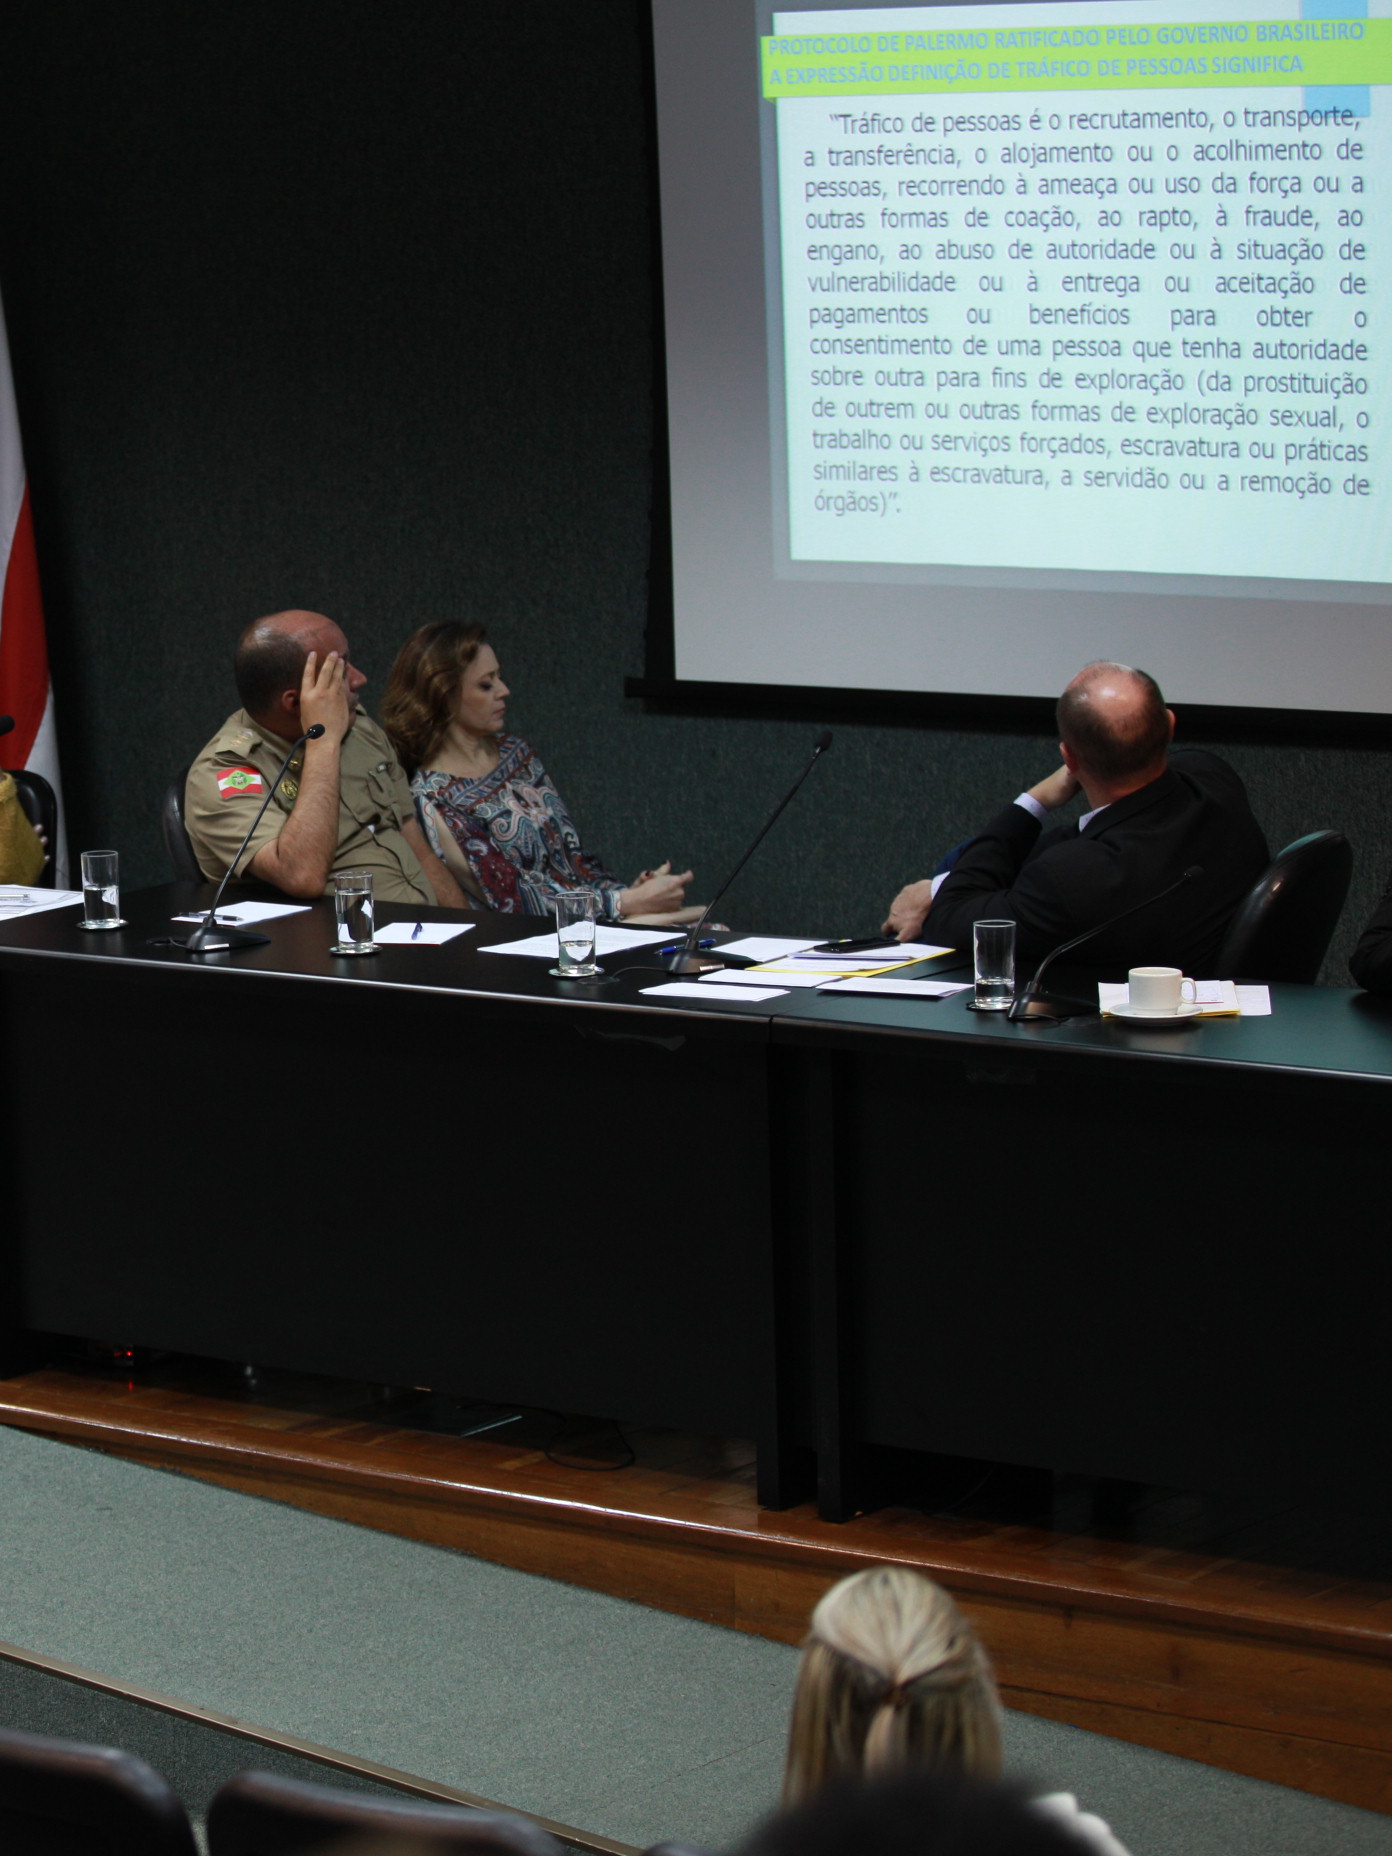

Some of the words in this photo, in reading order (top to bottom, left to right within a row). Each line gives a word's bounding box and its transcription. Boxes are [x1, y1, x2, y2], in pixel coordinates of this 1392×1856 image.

[769, 35, 872, 55] PROTOCOLO
[877, 34, 900, 52] DE
[905, 32, 989, 51] PALERMO
[995, 29, 1100, 49] RATIFICADO
[1107, 28, 1151, 46] PELO
[1157, 25, 1249, 44] GOVERNO
[1257, 22, 1365, 42] BRASILEIRO
[770, 69, 782, 85] A
[786, 62, 884, 84] EXPRESSÃO
[888, 59, 981, 84] DEFINIÇÃO
[988, 62, 1011, 79] DE
[1017, 56, 1090, 78] TRÁFICO
[1098, 59, 1121, 77] DE
[1127, 57, 1208, 75] PESSOAS
[1212, 55, 1304, 74] SIGNIFICA
[911, 112, 937, 133] de
[943, 114, 1023, 138] pessoas
[1029, 107, 1043, 131] é
[1048, 113, 1062, 131] o
[1069, 107, 1215, 132] recrutamento,
[1223, 110, 1238, 128] o
[1243, 105, 1360, 133] transporte,
[804, 150, 816, 167] a
[827, 142, 961, 167] transferência,
[975, 147, 988, 165] o
[1001, 142, 1115, 169] alojamento
[1127, 145, 1154, 163] ou
[1166, 144, 1180, 162] o
[1193, 138, 1323, 162] acolhimento
[1336, 137, 1365, 161] de
[805, 179, 887, 203] pessoas,
[898, 174, 1006, 197] recorrendo
[1015, 172, 1029, 195] à
[1038, 177, 1119, 200] ameaça
[1128, 177, 1155, 195] ou
[1165, 176, 1203, 194] uso
[1211, 171, 1239, 194] da
[1249, 170, 1303, 199] força
[1313, 175, 1341, 194] ou
[1351, 175, 1365, 194] a
[805, 210, 866, 229] outras
[880, 207, 949, 229] formas
[964, 206, 991, 228] de
[1004, 205, 1081, 233] coação,
[1097, 209, 1123, 227] ao
[1139, 206, 1199, 232] rapto,
[1215, 203, 1229, 227] à
[1245, 204, 1321, 232] fraude,
[1337, 209, 1365, 227] ao
[807, 243, 885, 266] engano,
[899, 243, 923, 261] ao
[935, 239, 995, 260] abuso
[1008, 239, 1035, 260] de
[1046, 238, 1157, 260] autoridade
[1169, 242, 1197, 260] ou
[1209, 236, 1224, 260] à
[1236, 237, 1325, 266] situação
[1338, 238, 1367, 261] de
[807, 270, 957, 293] vulnerabilidade
[979, 275, 1004, 293] ou
[1027, 269, 1039, 293] à
[1061, 273, 1141, 299] entrega
[1164, 275, 1191, 293] ou
[1215, 270, 1316, 300] aceitação
[1339, 271, 1367, 295] de
[809, 305, 929, 329] pagamentos
[966, 307, 991, 325] ou
[1029, 301, 1131, 325] benefícios
[1171, 308, 1217, 331] para
[1256, 304, 1314, 328] obter
[1354, 310, 1369, 329] o
[810, 335, 953, 355] consentimento
[963, 335, 989, 356] de
[997, 339, 1043, 357] uma
[1052, 339, 1123, 361] pessoa
[1132, 339, 1173, 363] que
[1181, 337, 1243, 359] tenha
[1252, 338, 1369, 361] autoridade
[811, 365, 865, 387] sobre
[875, 367, 926, 387] outra
[937, 370, 981, 392] para
[991, 366, 1027, 389] fins
[1039, 367, 1063, 389] de
[1075, 368, 1186, 396] exploração
[1197, 369, 1233, 397] (da
[1243, 371, 1369, 400] prostituição
[812, 397, 836, 418] de
[845, 399, 915, 419] outrem
[925, 402, 949, 419] ou
[959, 401, 1021, 421] outras
[1031, 399, 1102, 423] formas
[1111, 401, 1137, 423] de
[1146, 402, 1259, 431] exploração
[1269, 405, 1344, 433] sexual,
[1356, 411, 1371, 429] o
[812, 429, 892, 450] trabalho
[899, 433, 924, 451] ou
[931, 433, 1011, 458] serviços
[1020, 431, 1111, 459] forçados,
[1120, 437, 1241, 459] escravatura
[1249, 441, 1276, 459] ou
[1285, 437, 1369, 466] práticas
[813, 461, 899, 482] similares
[909, 460, 920, 482] à
[930, 465, 1049, 488] escravatura,
[1061, 469, 1073, 486] a
[1084, 466, 1170, 489] servidão
[1179, 472, 1205, 490] ou
[1217, 473, 1231, 491] a
[1240, 471, 1333, 499] remoção
[1343, 473, 1372, 496] de
